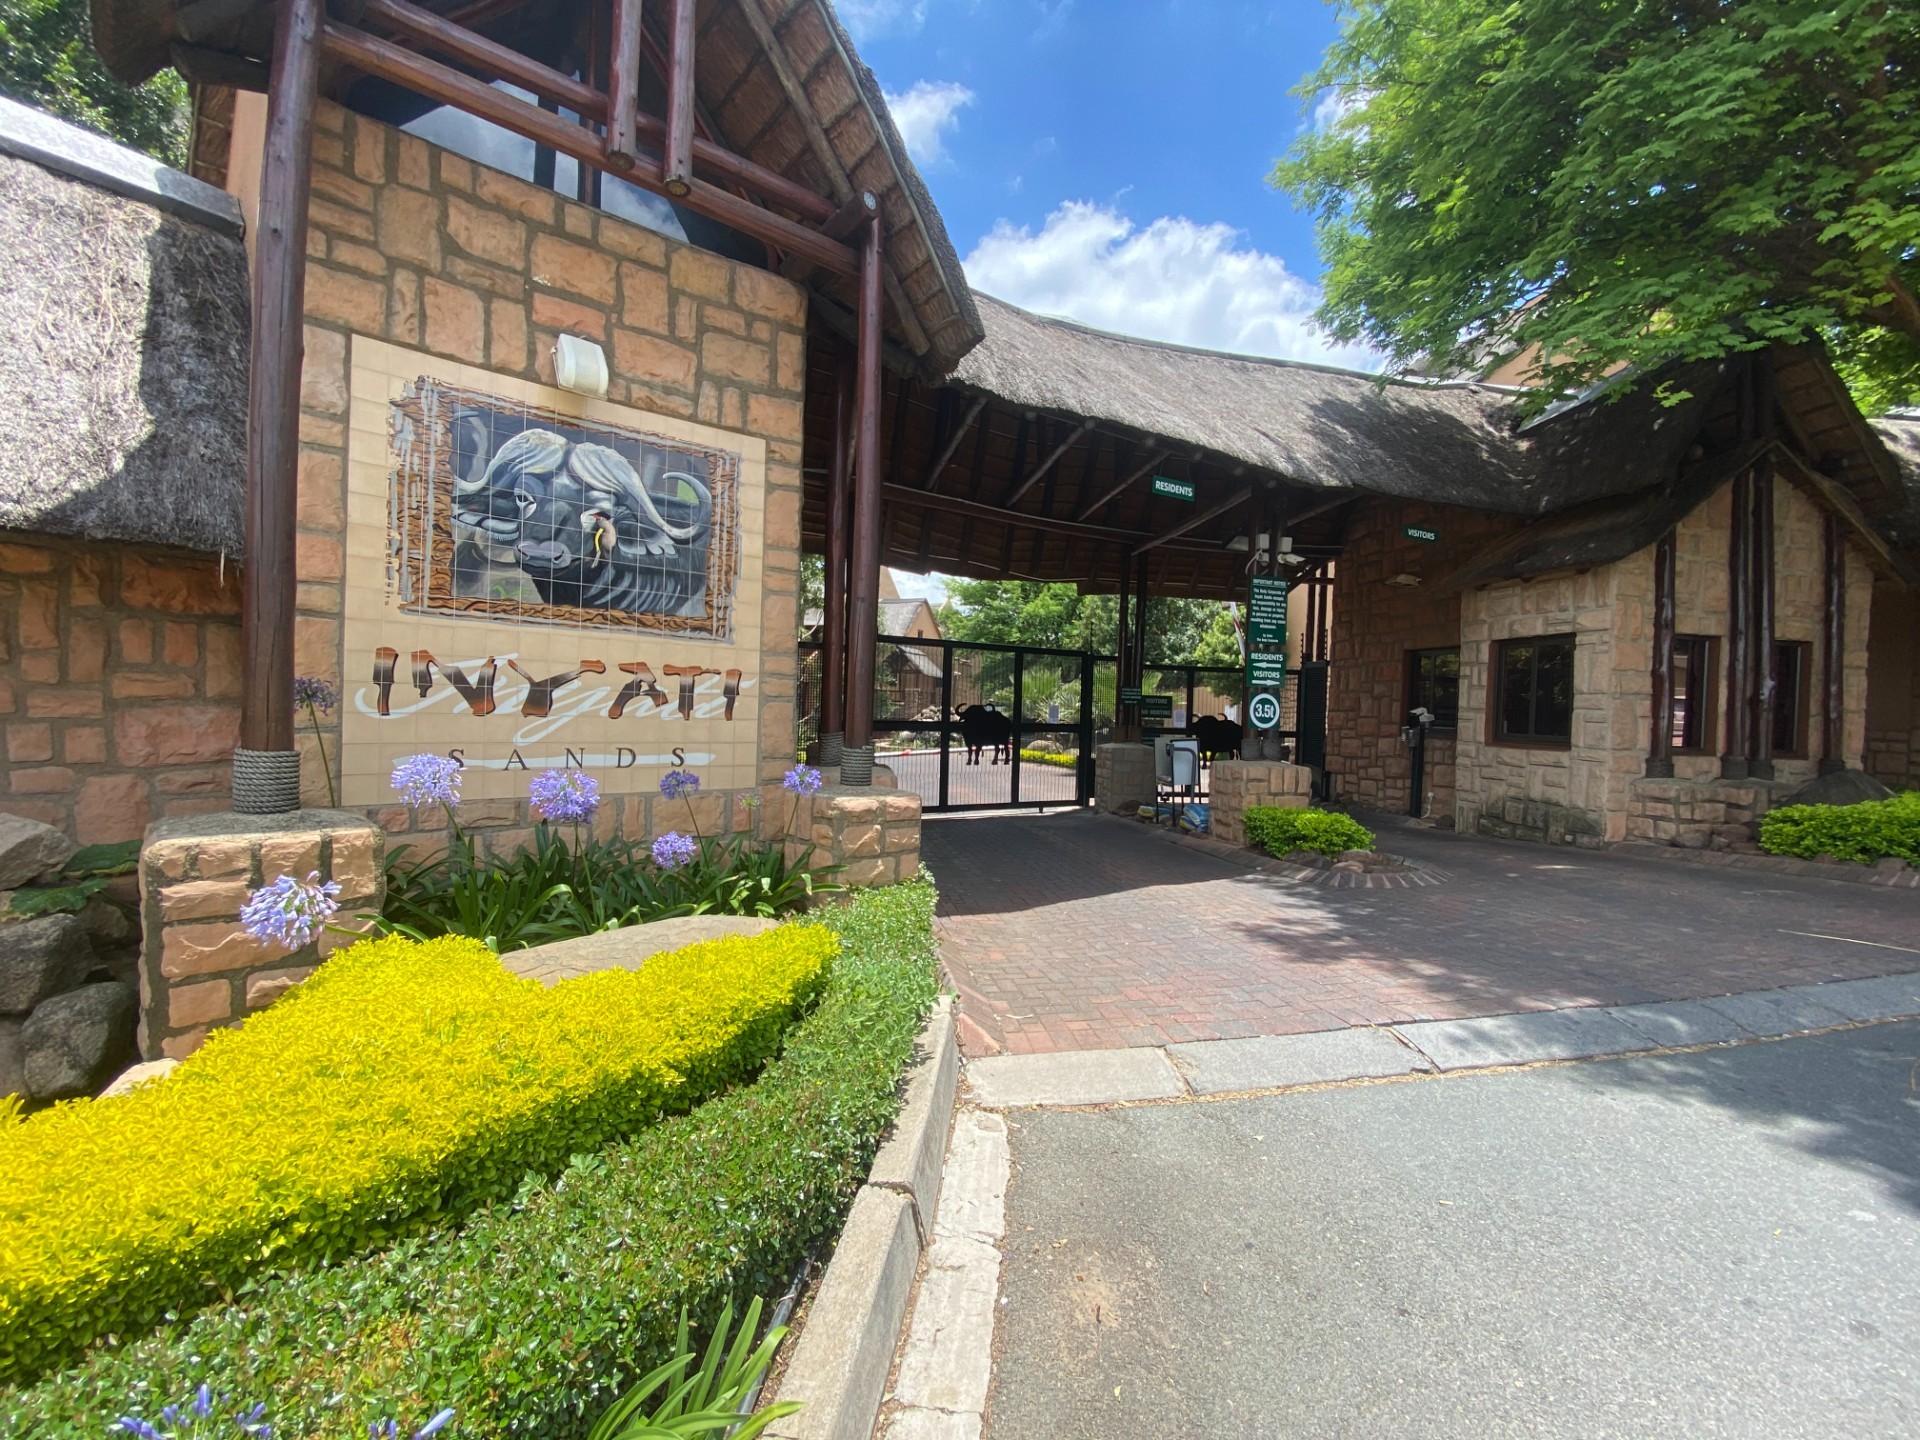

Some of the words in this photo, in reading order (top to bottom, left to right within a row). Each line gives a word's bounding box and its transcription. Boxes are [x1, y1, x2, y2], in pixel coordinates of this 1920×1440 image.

[1155, 480, 1193, 497] RESIDENTS
[1407, 528, 1435, 541] VISITORS
[1251, 652, 1283, 661] RESIDENTS
[1253, 670, 1280, 679] VISITORS
[372, 646, 742, 721] INYATI
[1255, 704, 1274, 718] 3.5t
[448, 747, 685, 771] SANDS
